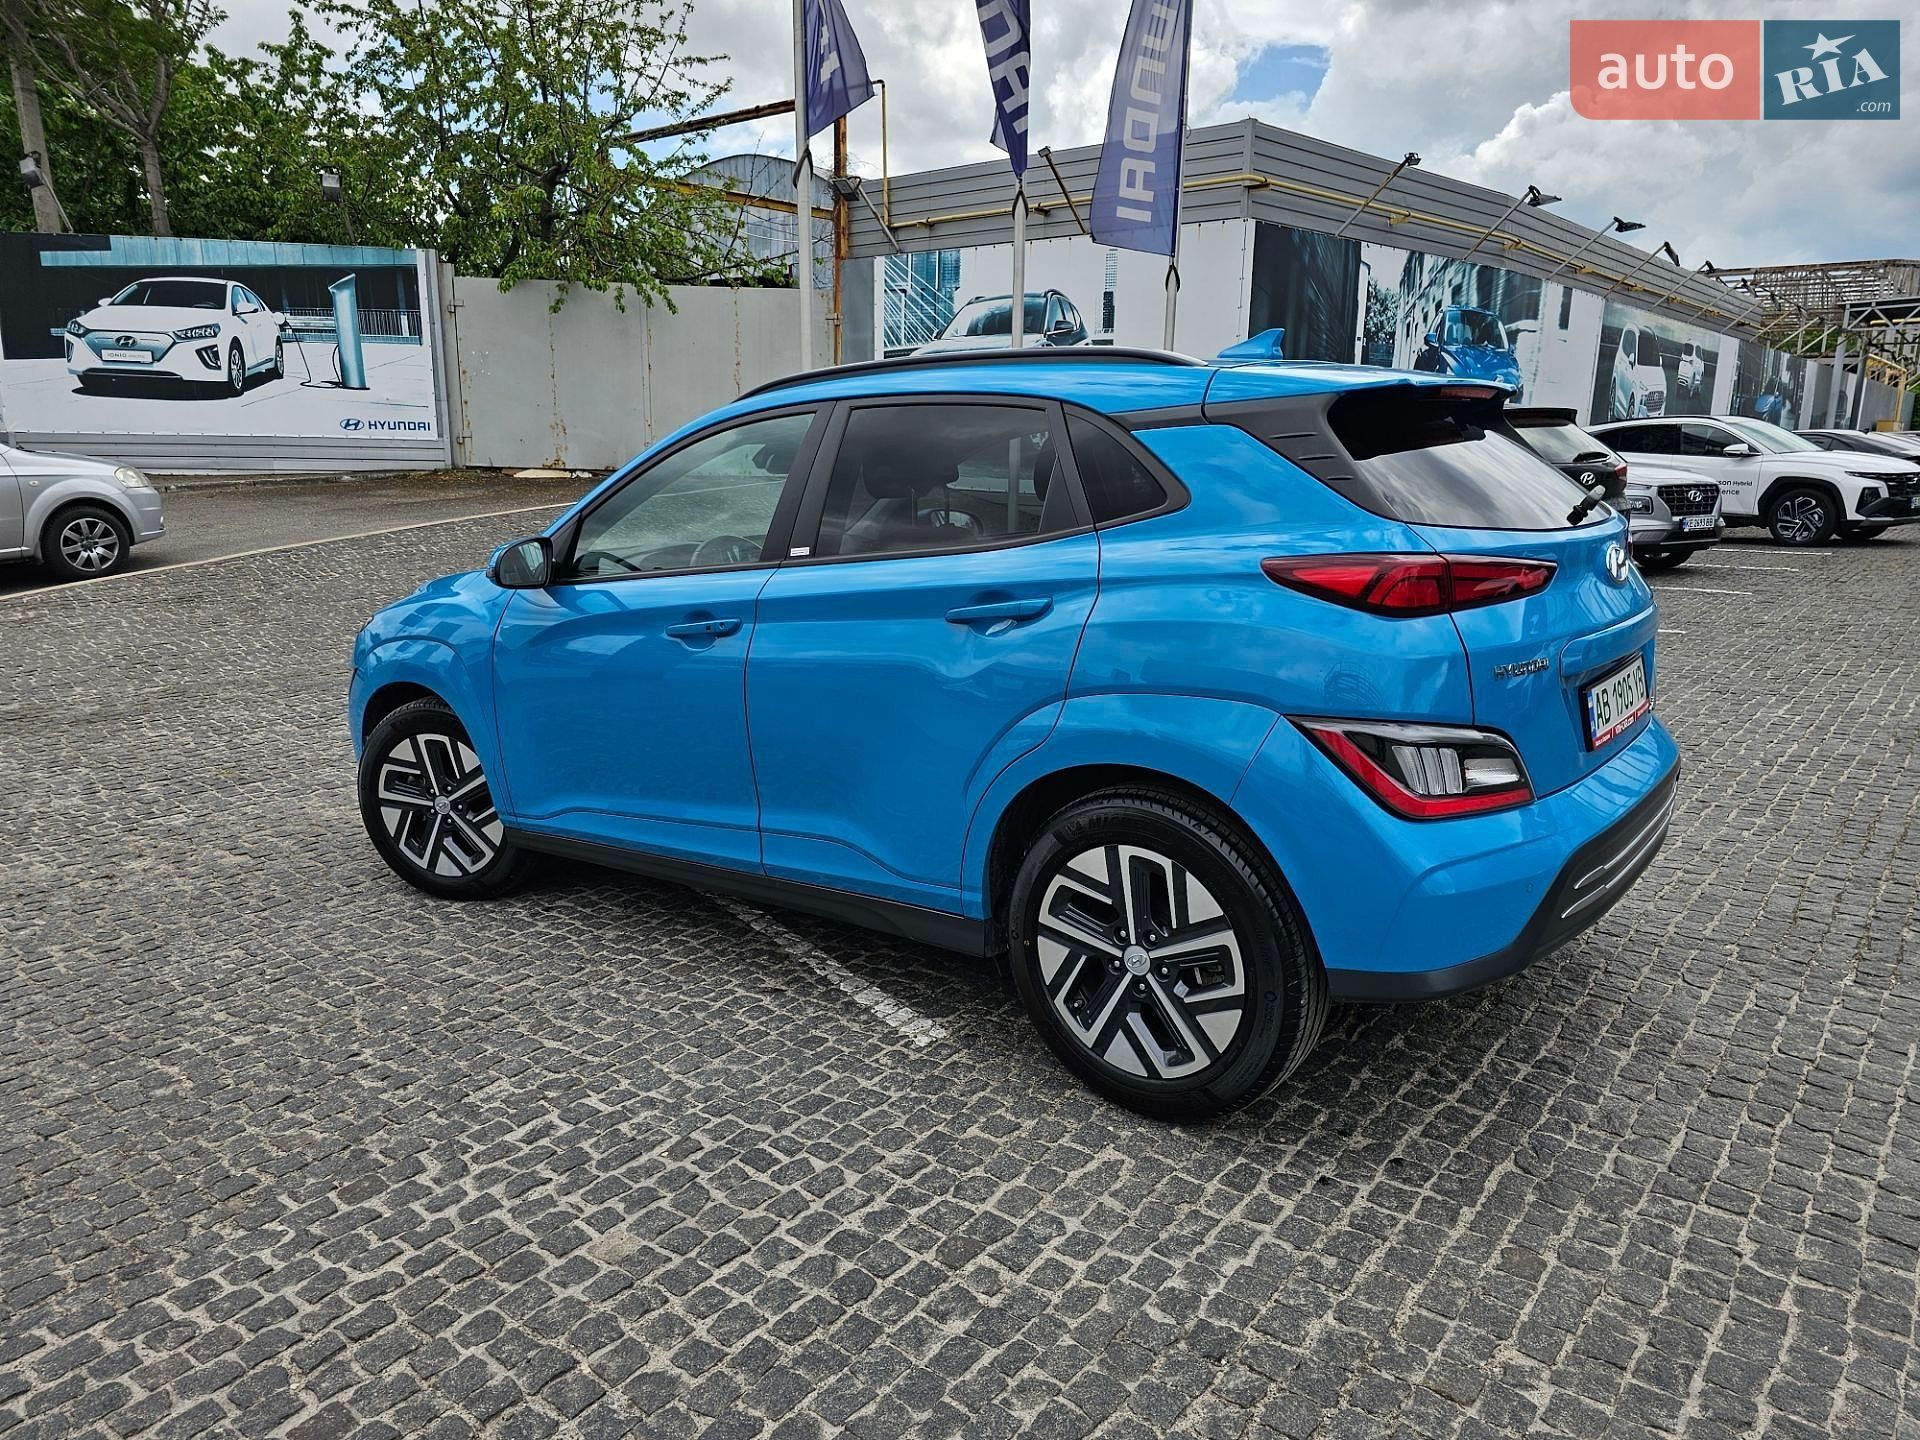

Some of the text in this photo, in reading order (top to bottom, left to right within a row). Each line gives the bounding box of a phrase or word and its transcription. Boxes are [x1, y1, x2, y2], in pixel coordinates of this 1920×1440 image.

[368, 420, 431, 431] HYUNDAI
[1596, 688, 1611, 729] AB
[1612, 673, 1633, 716] 1905
